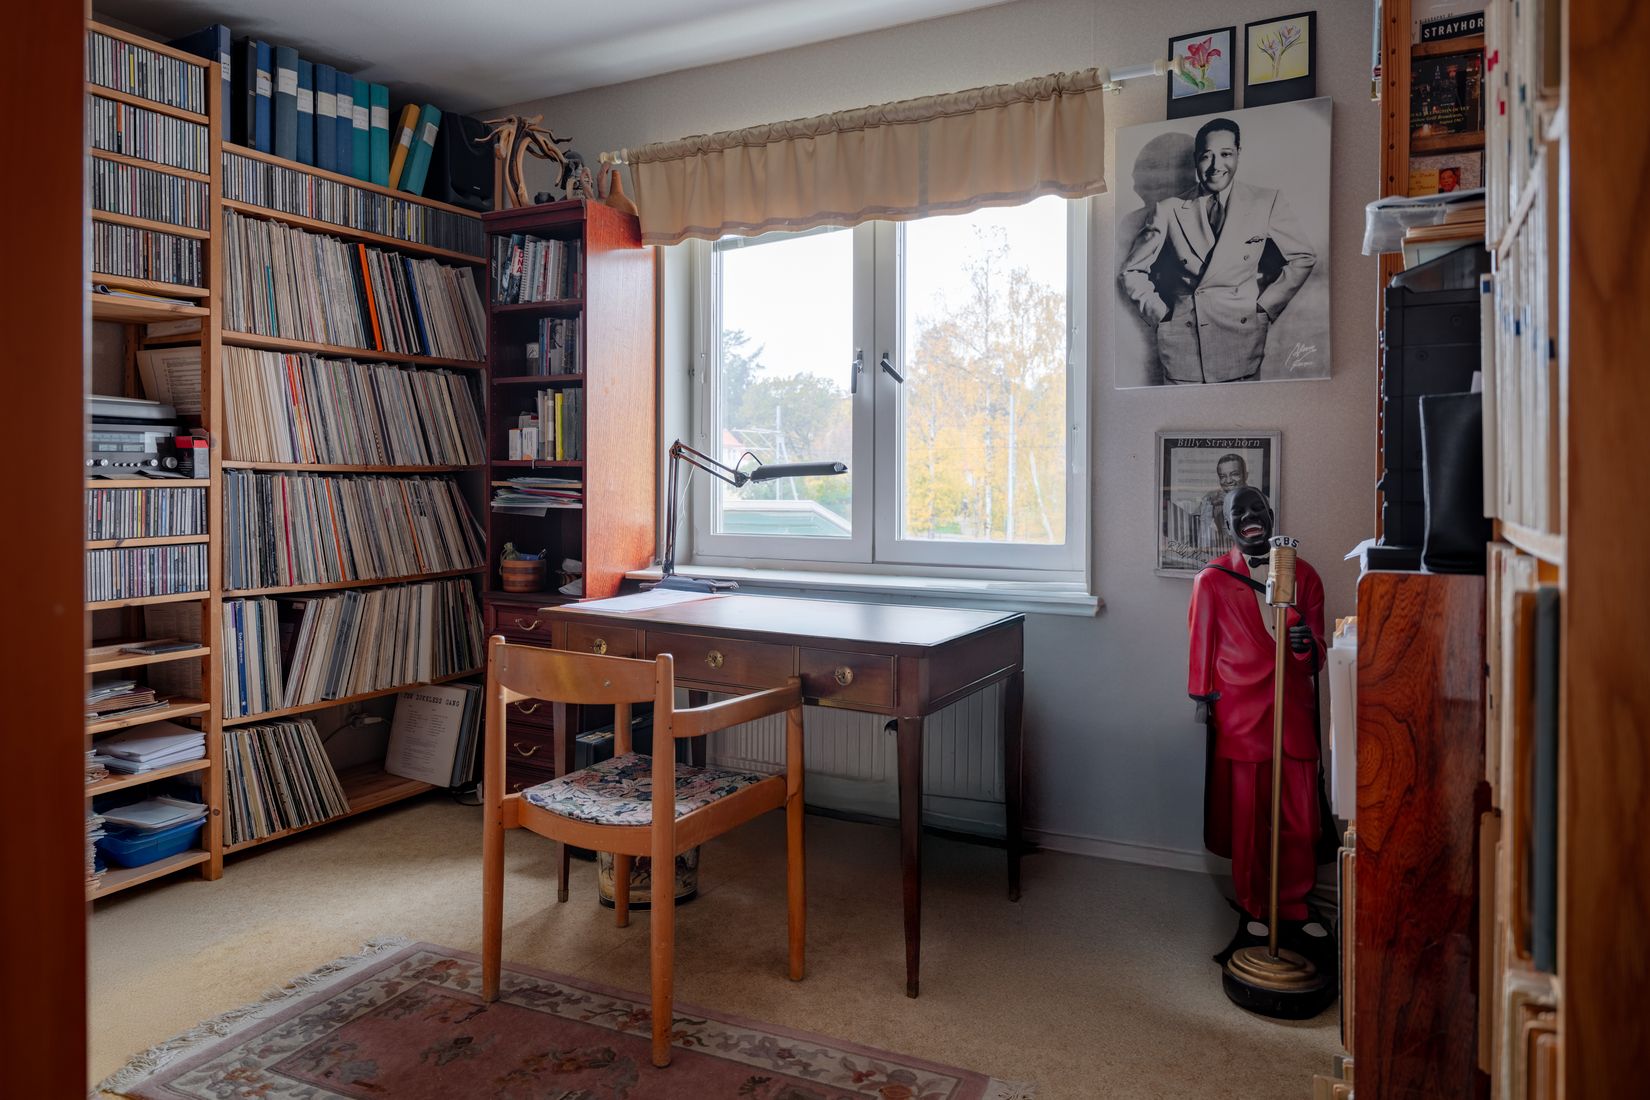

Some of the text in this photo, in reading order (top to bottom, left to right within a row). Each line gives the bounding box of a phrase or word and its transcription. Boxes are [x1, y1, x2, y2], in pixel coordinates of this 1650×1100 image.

[1177, 438, 1260, 449] Billy Strayhorn
[1274, 536, 1300, 548] CBS
